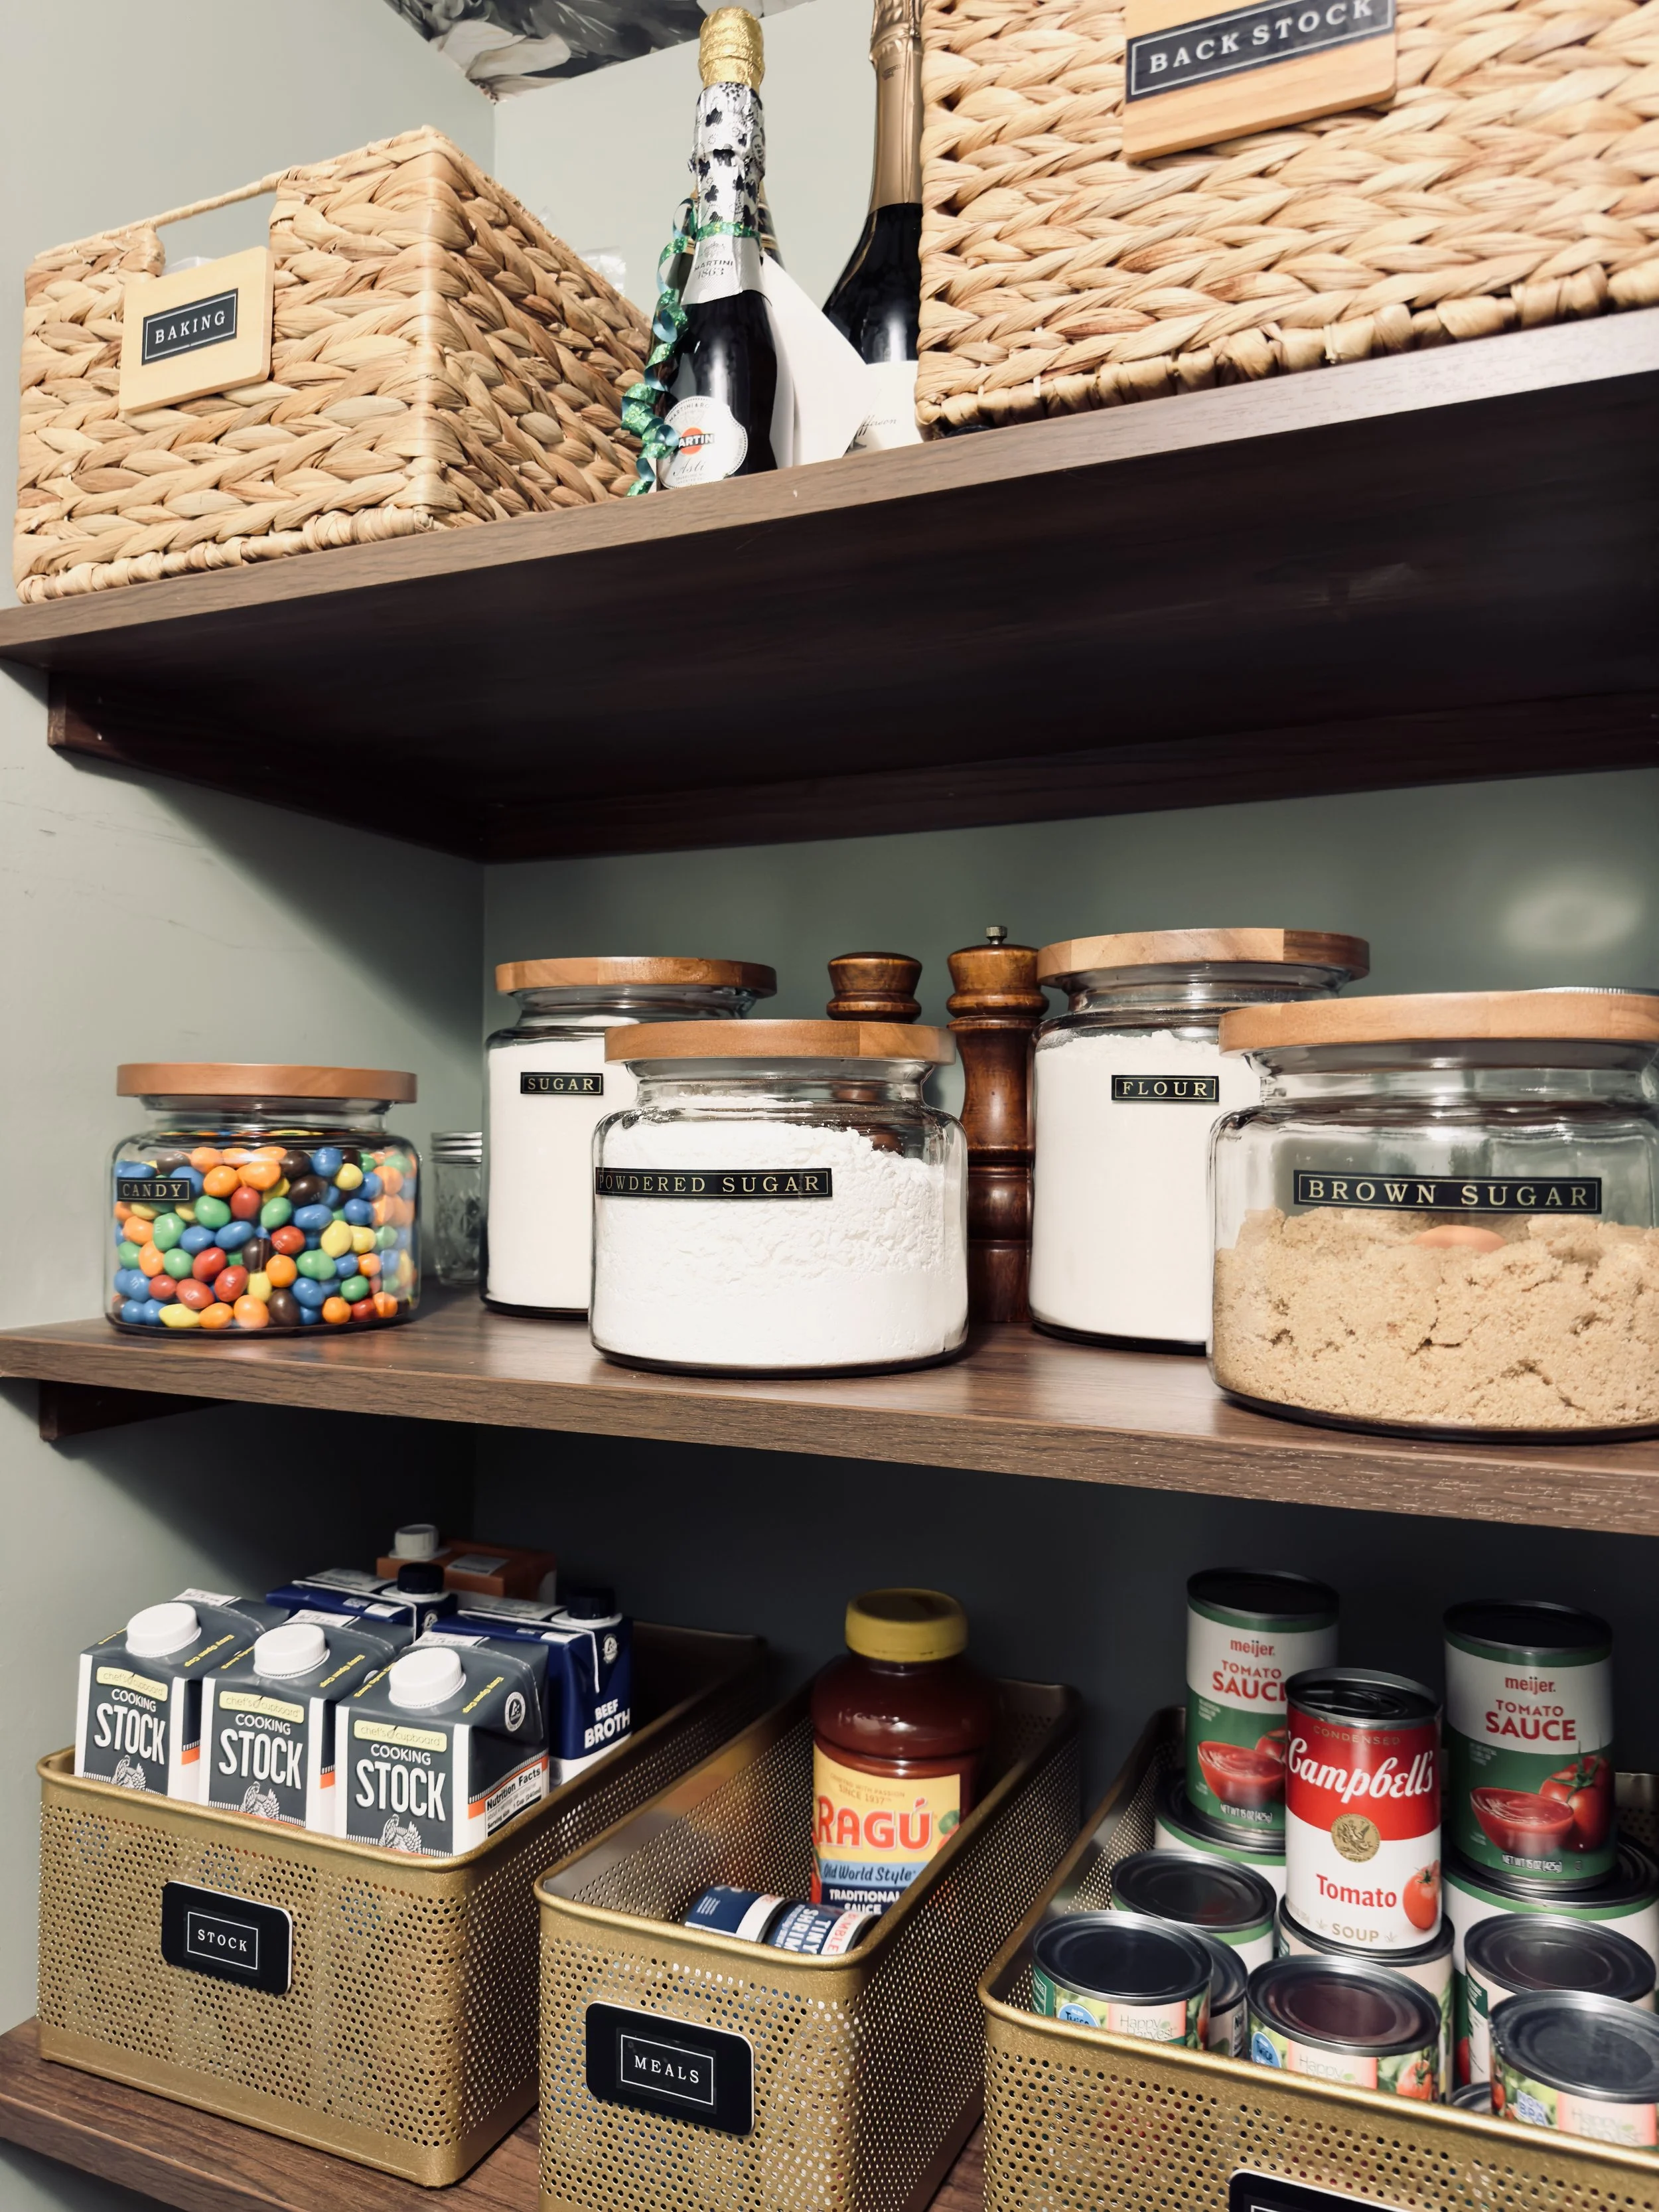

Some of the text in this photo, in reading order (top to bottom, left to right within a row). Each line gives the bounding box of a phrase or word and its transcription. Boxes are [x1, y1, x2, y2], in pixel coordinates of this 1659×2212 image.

[1149, 0, 1374, 74] BACK STOCK
[694, 259, 733, 272] MARTINI
[699, 267, 724, 279] 1863
[155, 310, 225, 344] BAKING
[678, 434, 714, 449] ARTIN
[528, 1078, 594, 1090] SUGAR
[1122, 1081, 1208, 1096] FLOUR
[122, 1183, 182, 1197] CANDY
[599, 1174, 820, 1193] POWDERED SUGAR
[1309, 1179, 1588, 1207] BROWN SUGAR
[1221, 1660, 1282, 1680] TOMATO
[111, 1688, 157, 1712] COOKING
[226, 1696, 253, 1708] chef's
[595, 1698, 618, 1721] BEEF
[1496, 1699, 1564, 1717] TOMATO
[94, 1702, 167, 1765] STOCK
[236, 1713, 291, 1735] COOKING
[584, 1708, 630, 1749] BROTH
[1485, 1711, 1576, 1741] SAUCE
[360, 1726, 442, 1746] chef's cupboard
[1313, 1726, 1401, 1746] CONDENSED
[218, 1728, 303, 1790] STOCK
[370, 1743, 431, 1766] COOKING
[1288, 1730, 1433, 1804] Campbell's
[355, 1759, 447, 1822] STOCK
[487, 1783, 516, 1811] Nutrition
[518, 1767, 541, 1787] Facts
[839, 1784, 861, 1800] SINCE
[817, 1795, 932, 1851] RAGÚ
[824, 1862, 912, 1884] Old World Style
[1316, 1874, 1397, 1907] Tomato
[844, 1903, 882, 1915] SAUCE
[198, 1929, 247, 1952] STOCK
[783, 1908, 819, 1952] SHRIM
[802, 1920, 831, 1954] TINY
[1332, 1923, 1379, 1943] SOUP
[1120, 2014, 1161, 2031] Happy
[634, 2055, 699, 2084] MEALS
[1299, 2054, 1344, 2079] Happy
